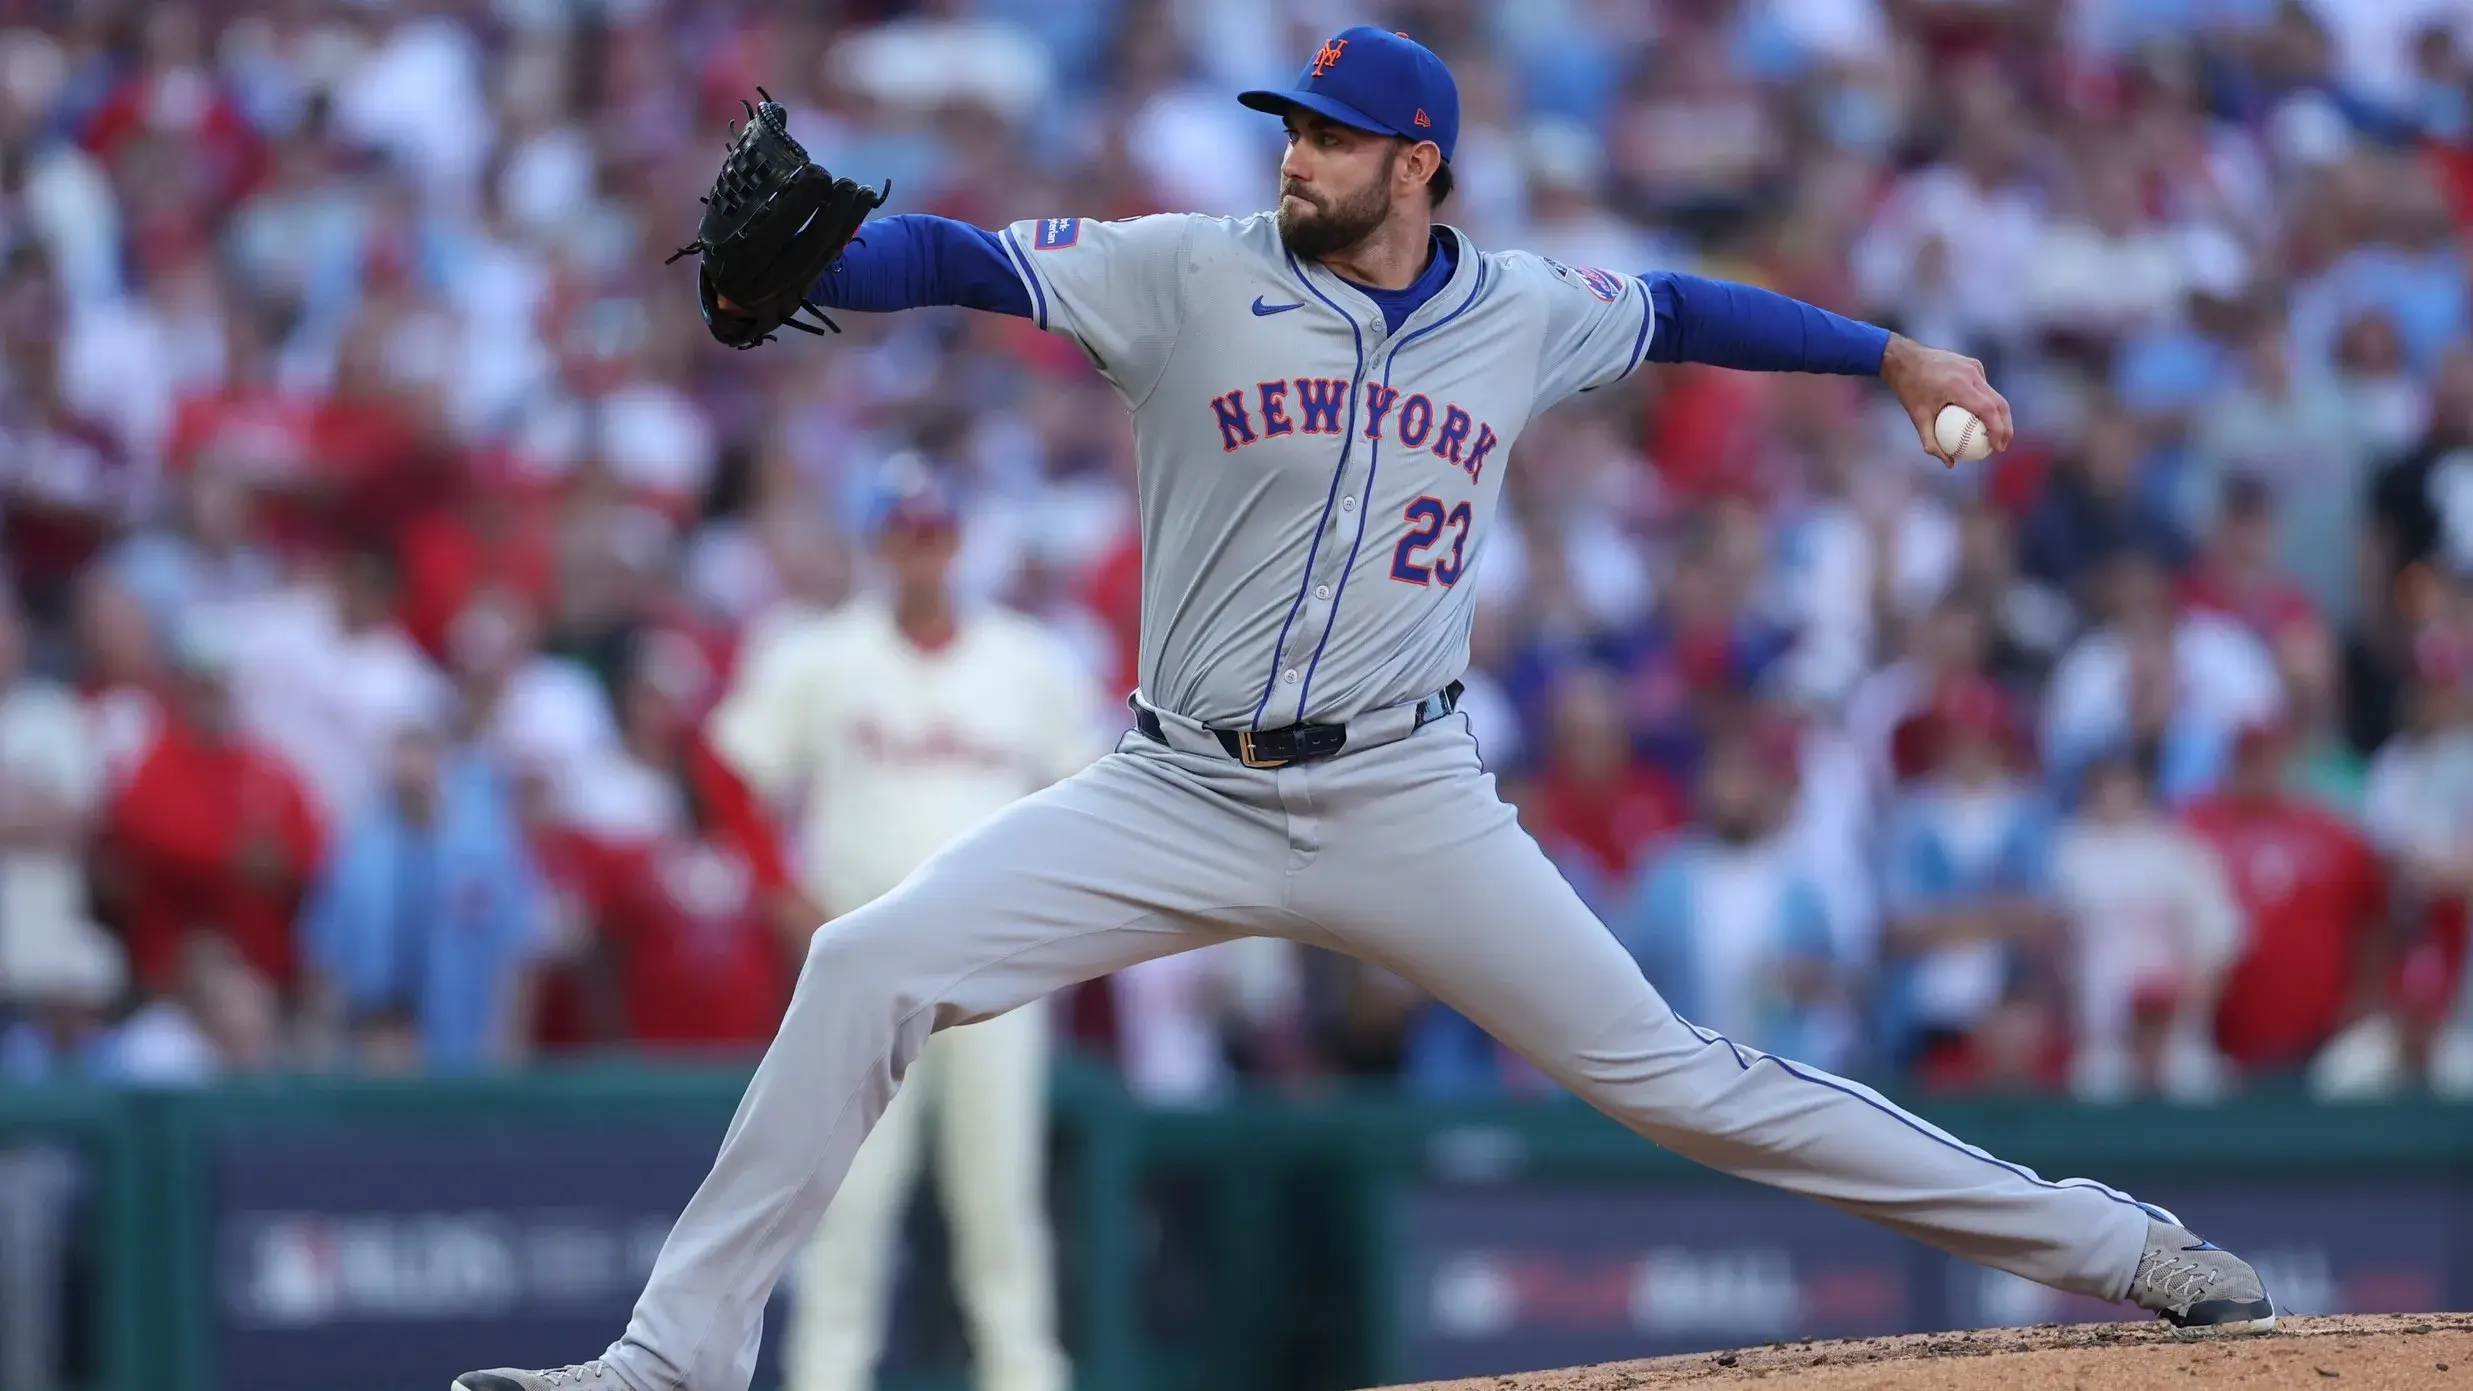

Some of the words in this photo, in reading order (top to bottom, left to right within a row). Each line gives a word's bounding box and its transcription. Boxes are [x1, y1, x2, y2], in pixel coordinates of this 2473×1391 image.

[1312, 38, 1348, 77] NY
[1210, 378, 1349, 452] NEW
[1363, 381, 1498, 485] YORK
[1389, 496, 1473, 588] 23
